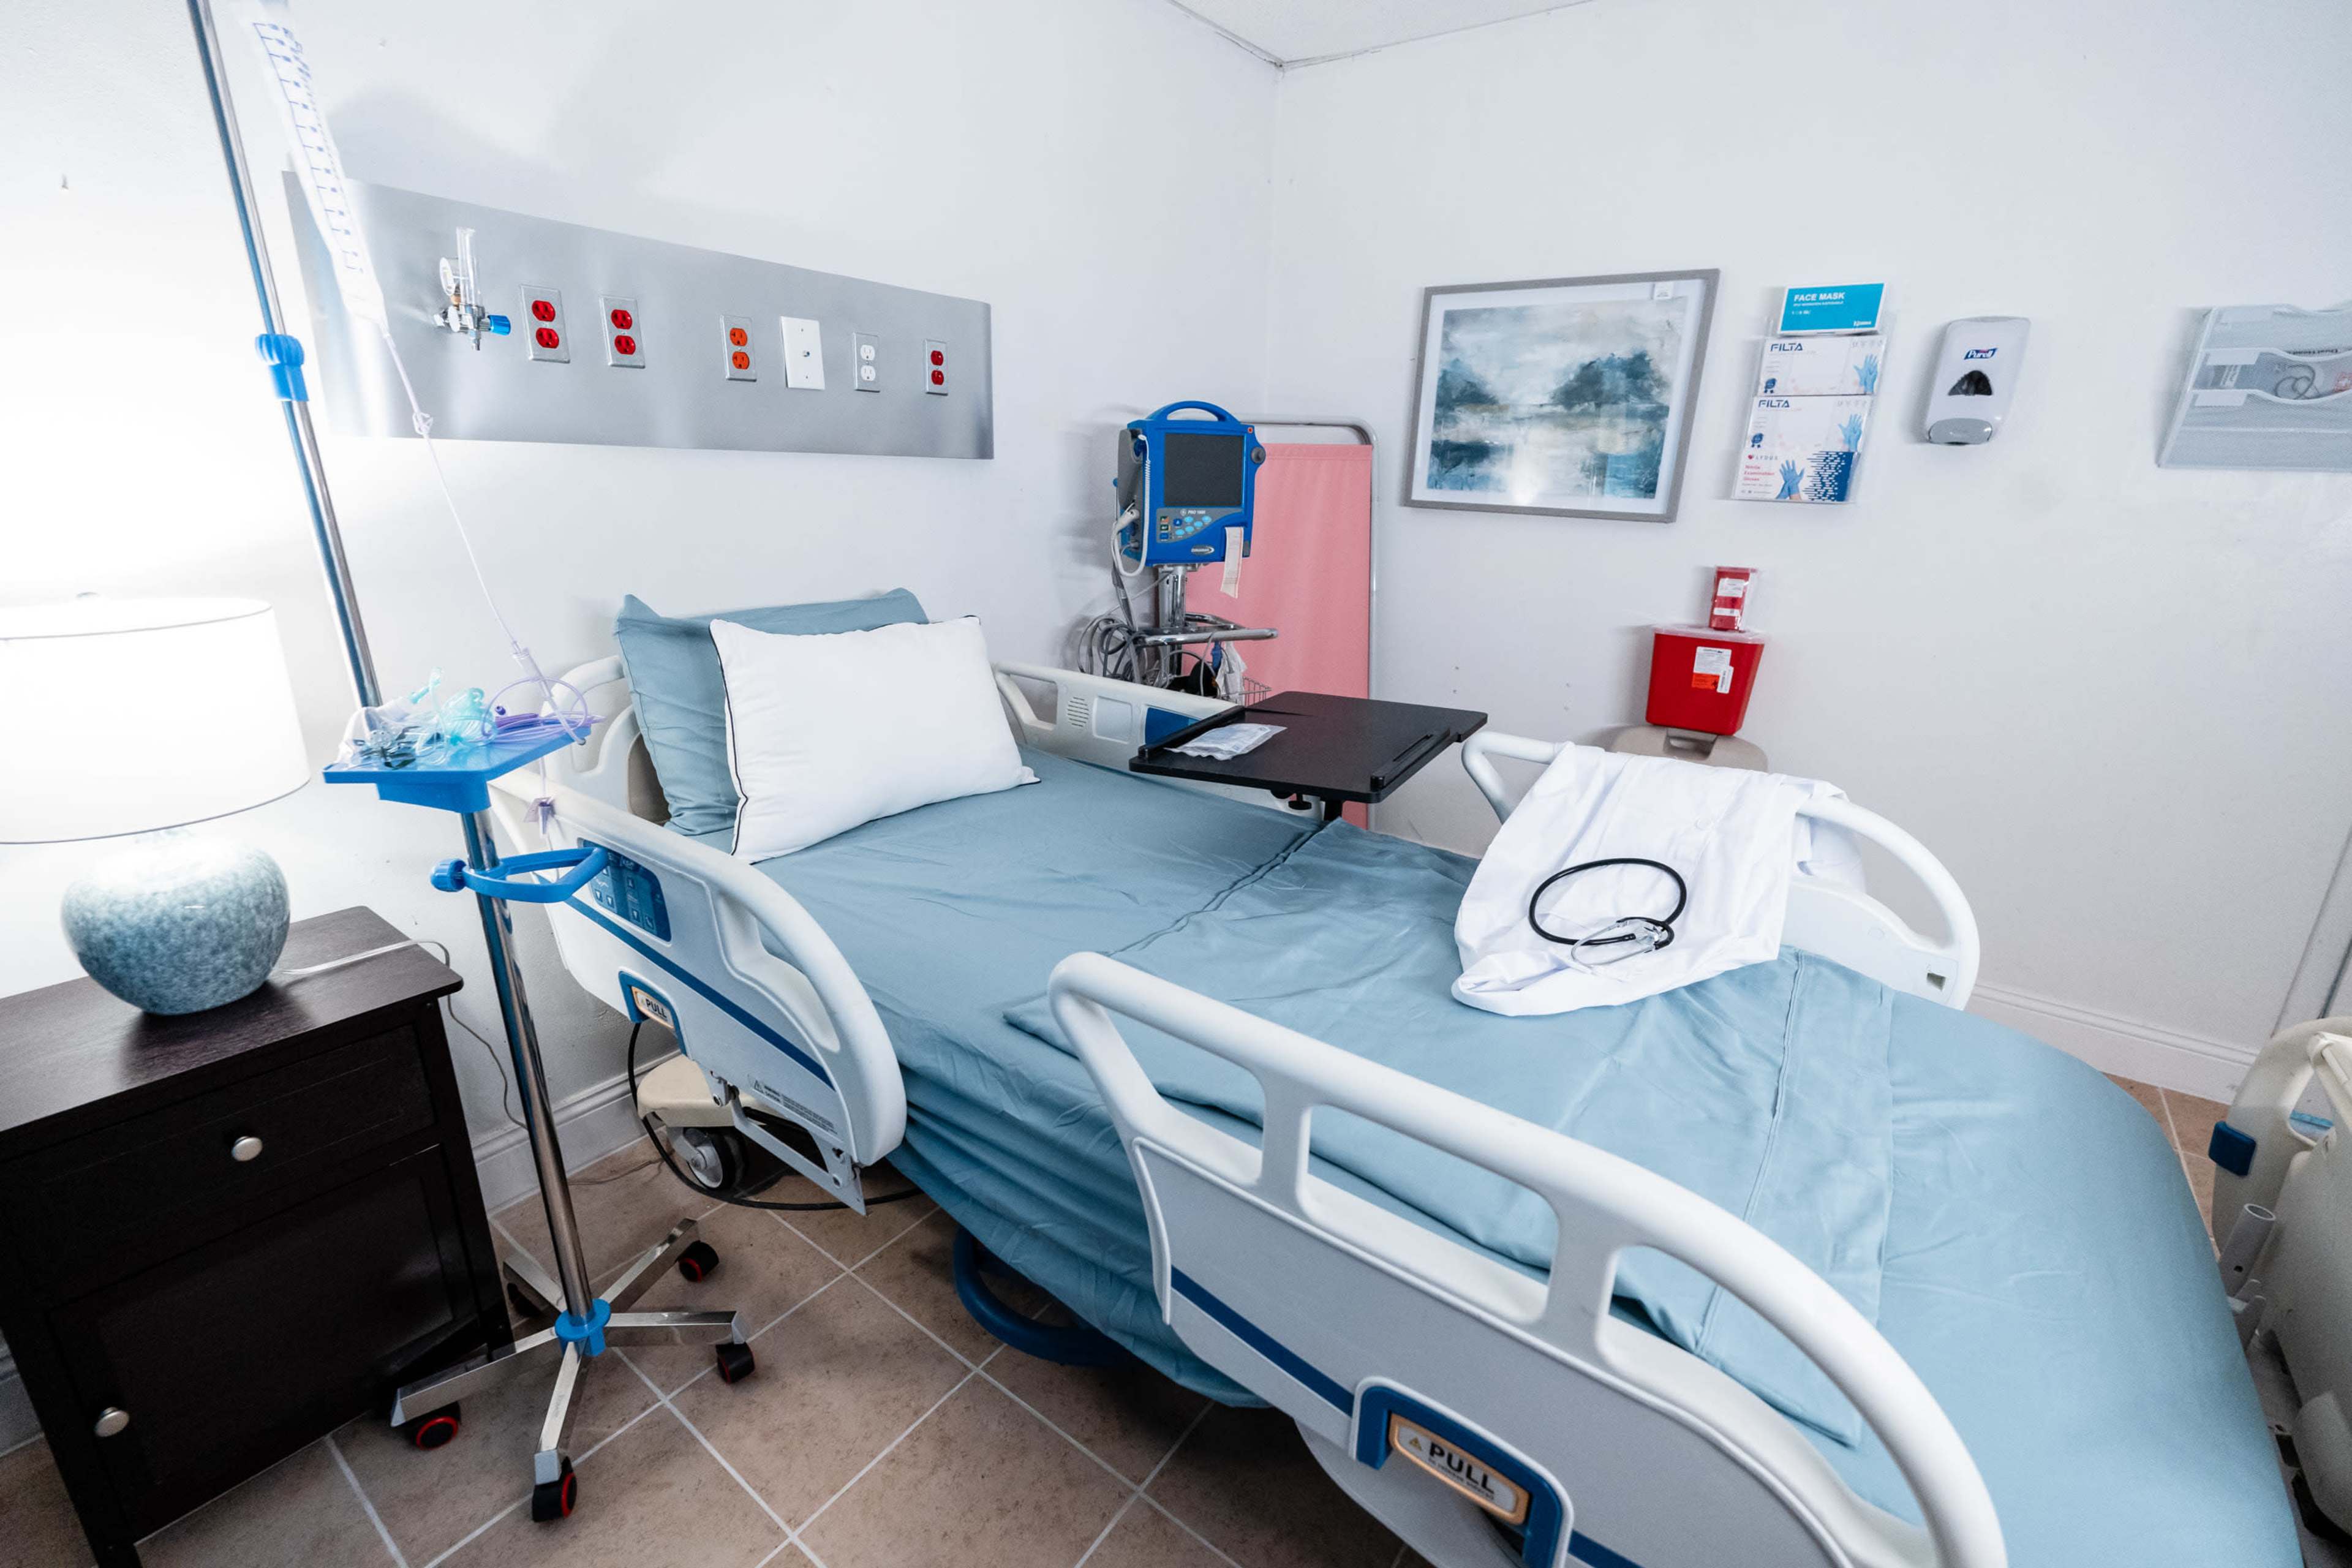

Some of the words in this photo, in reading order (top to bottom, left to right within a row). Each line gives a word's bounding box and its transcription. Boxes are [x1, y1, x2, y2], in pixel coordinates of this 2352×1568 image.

[1770, 343, 1803, 352] FILTA
[646, 998, 667, 1018] PULL
[1430, 1442, 1494, 1494] PULL
